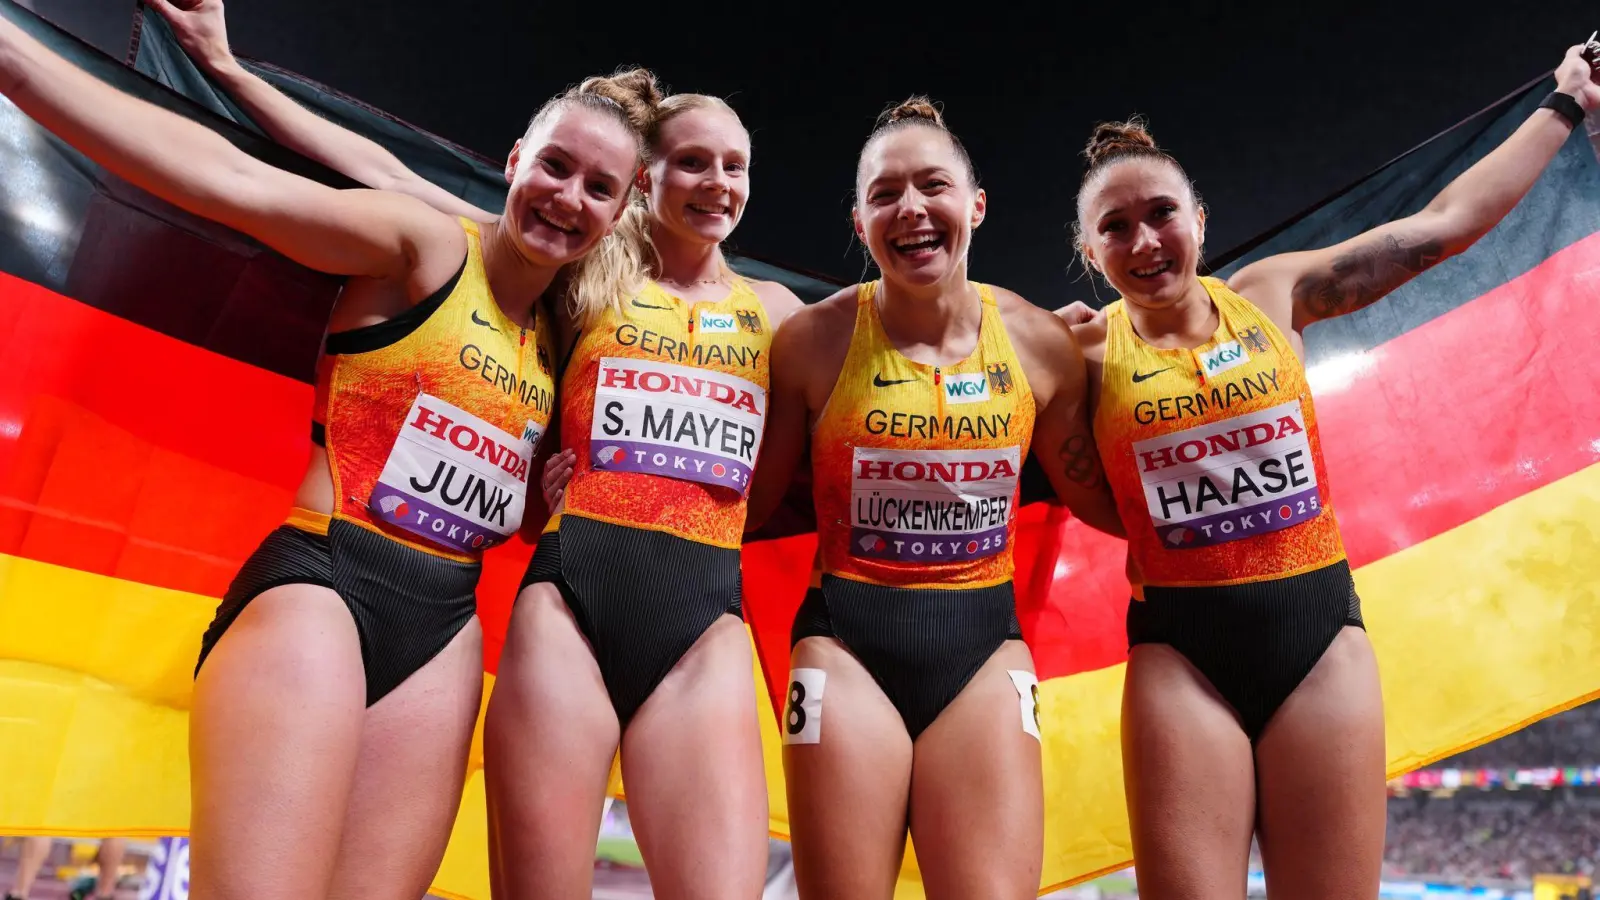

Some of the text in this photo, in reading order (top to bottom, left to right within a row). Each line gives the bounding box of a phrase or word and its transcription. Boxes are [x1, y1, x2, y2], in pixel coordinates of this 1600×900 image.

[701, 316, 735, 329] WGV
[615, 324, 760, 369] GERMANY
[1205, 344, 1242, 370] WGV
[601, 367, 762, 416] HONDA
[945, 379, 986, 396] WGV
[1134, 368, 1280, 425] GERMANY
[409, 405, 528, 483] HONDA
[523, 426, 542, 444] WG
[602, 401, 755, 462] S. MAYER
[865, 409, 1011, 440] GERMANY
[1139, 415, 1303, 473] HONDA
[731, 467, 749, 487] 25
[856, 459, 1016, 483] HONDA
[1157, 449, 1309, 520] HAASE
[409, 460, 513, 527] JUNK
[857, 491, 1008, 531] LÜCKENKEMPER
[1297, 495, 1318, 515] 25
[982, 534, 1002, 551] 25
[786, 680, 806, 735] 8
